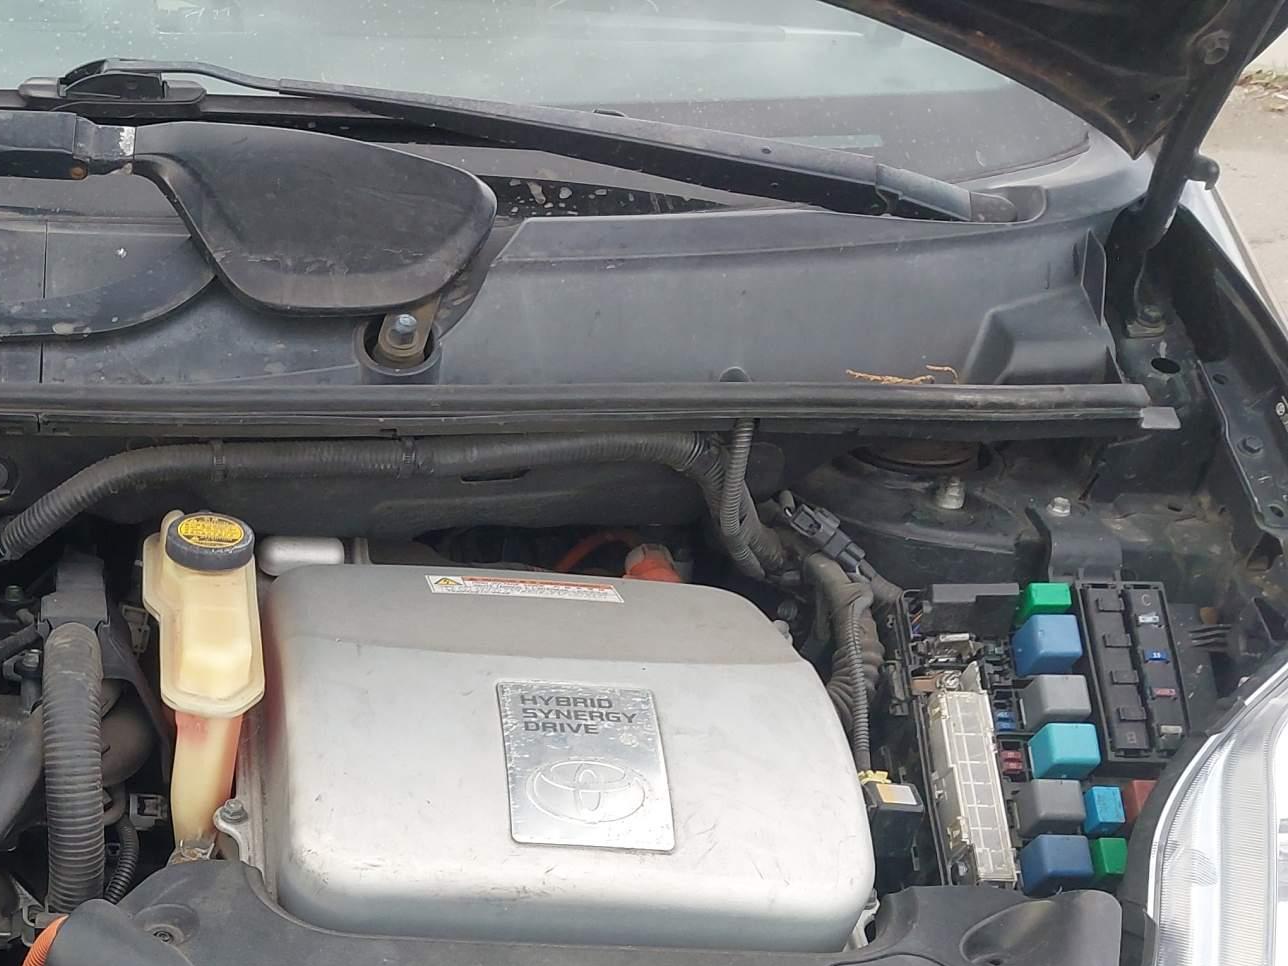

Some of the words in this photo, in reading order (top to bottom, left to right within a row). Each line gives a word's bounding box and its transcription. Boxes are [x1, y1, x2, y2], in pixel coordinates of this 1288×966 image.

[521, 695, 613, 709] HYBRID
[523, 708, 637, 723] SYNERGY
[524, 721, 600, 735] DRIVE
